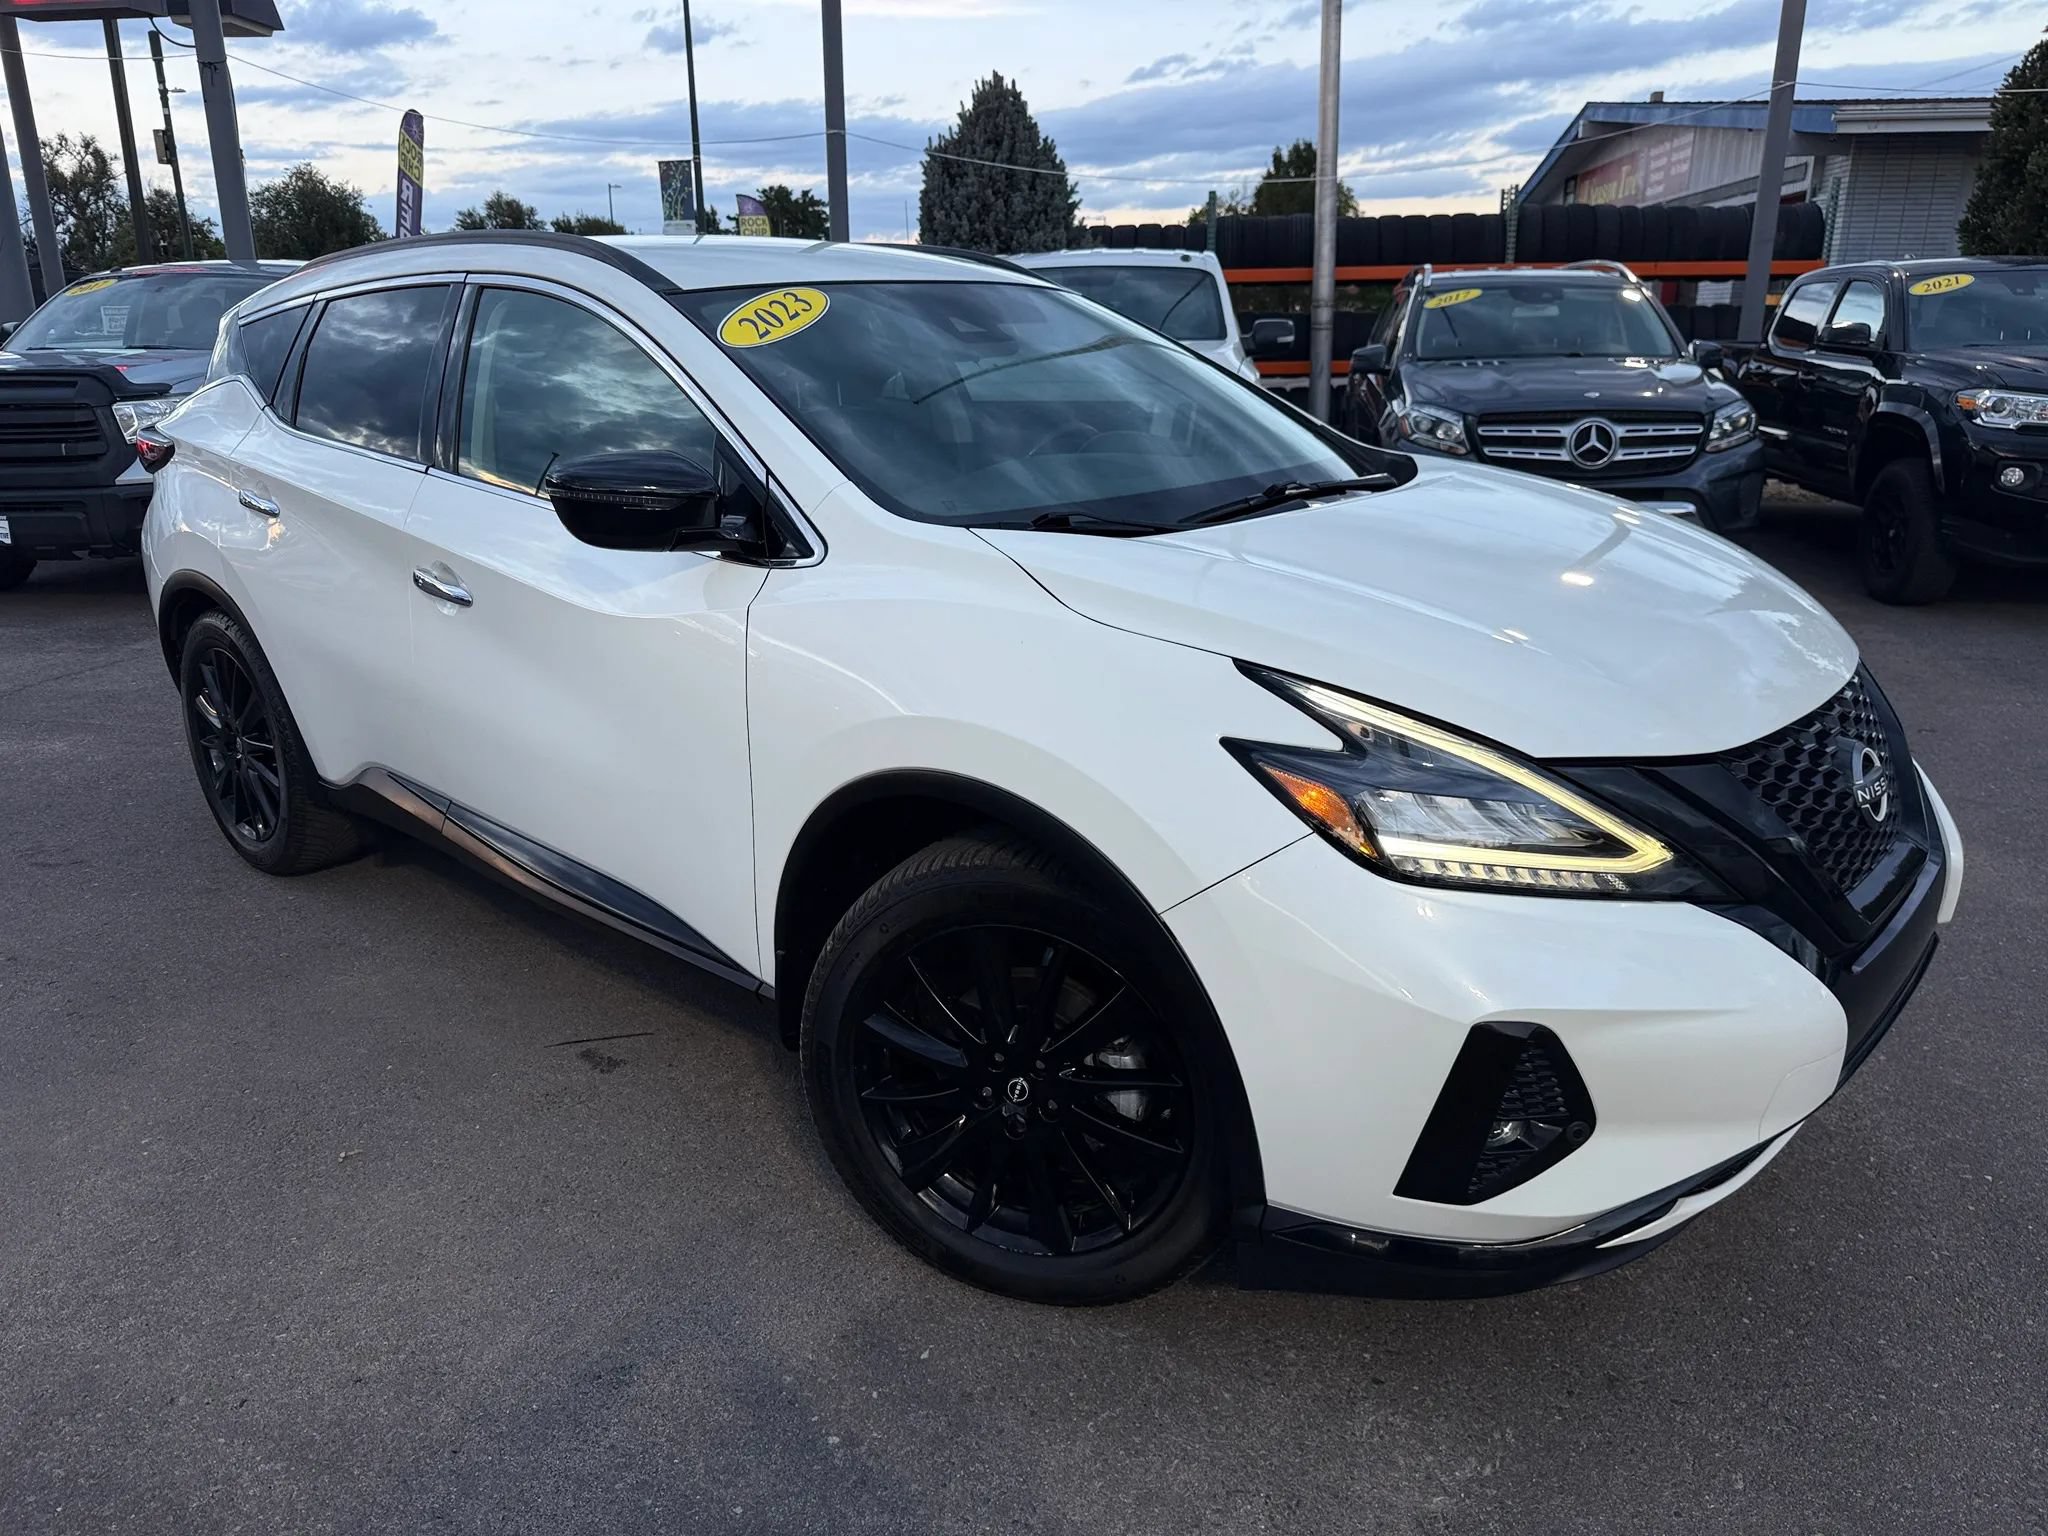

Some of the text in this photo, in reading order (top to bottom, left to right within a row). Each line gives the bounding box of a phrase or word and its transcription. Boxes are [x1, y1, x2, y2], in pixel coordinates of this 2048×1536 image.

[741, 217, 768, 228] ROCK
[743, 228, 768, 236] CHIP
[1923, 276, 1960, 293] 2021
[1434, 290, 1470, 305] 2017
[738, 291, 813, 340] 2023
[1857, 777, 1887, 803] NISS
